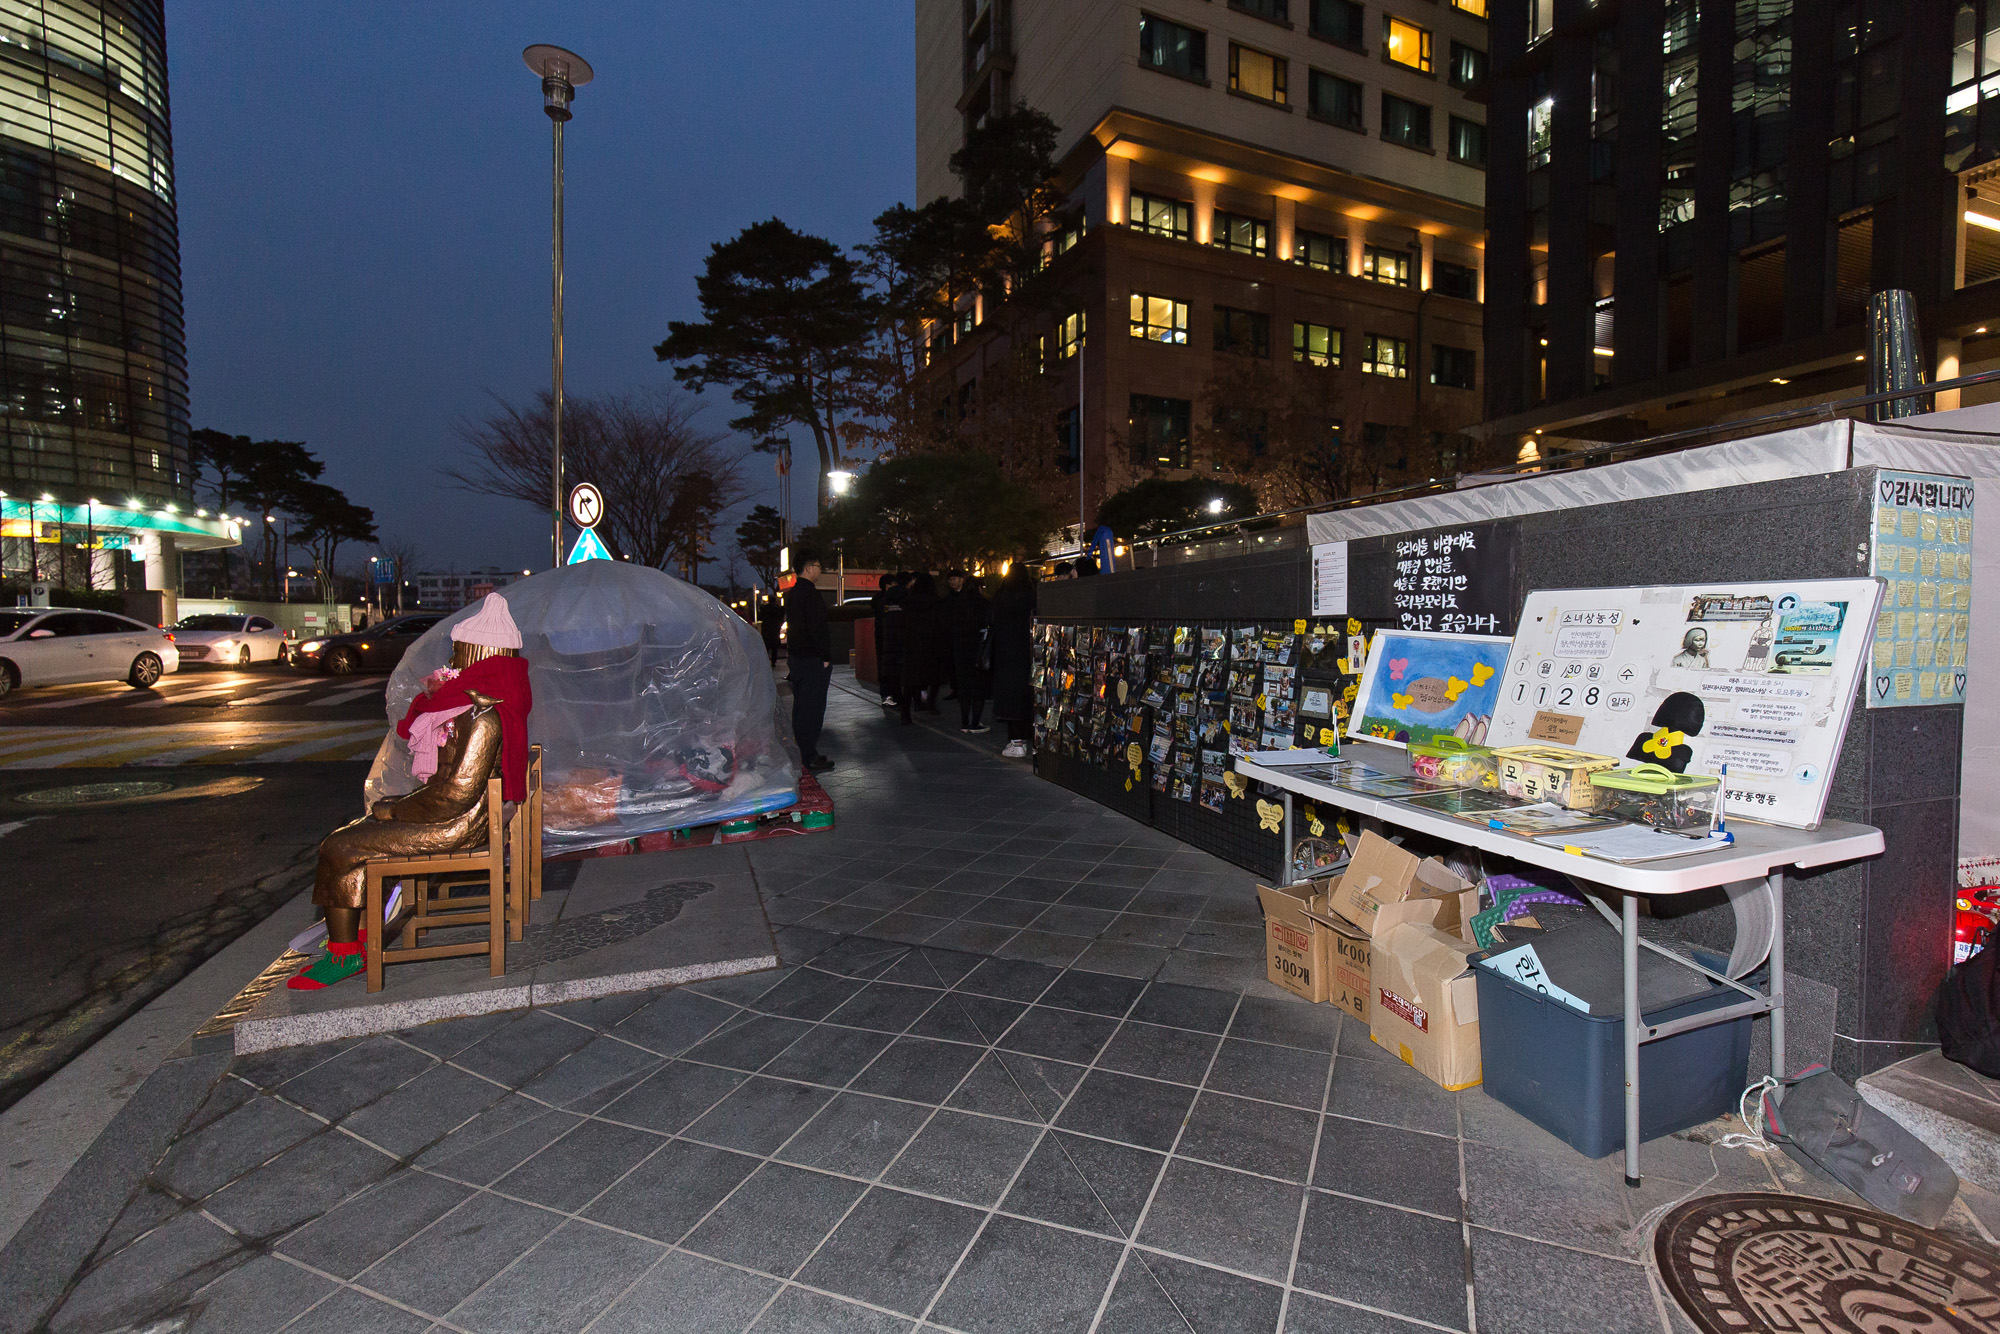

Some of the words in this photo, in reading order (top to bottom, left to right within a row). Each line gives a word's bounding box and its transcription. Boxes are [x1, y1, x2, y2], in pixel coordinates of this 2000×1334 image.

[1895, 481, 1965, 510] 감사합니다
[1434, 531, 1476, 554] 바람대로
[1420, 575, 1468, 591] 못했지만
[1394, 593, 1459, 609] 우리부모라도
[1401, 613, 1432, 631] 만나고
[1563, 612, 1619, 624] 소녀상농성
[1567, 664, 1582, 674] 30
[1589, 666, 1600, 678] 일
[1620, 668, 1634, 680] 수
[1611, 697, 1630, 707] 일차
[1275, 955, 1310, 986] 300개
